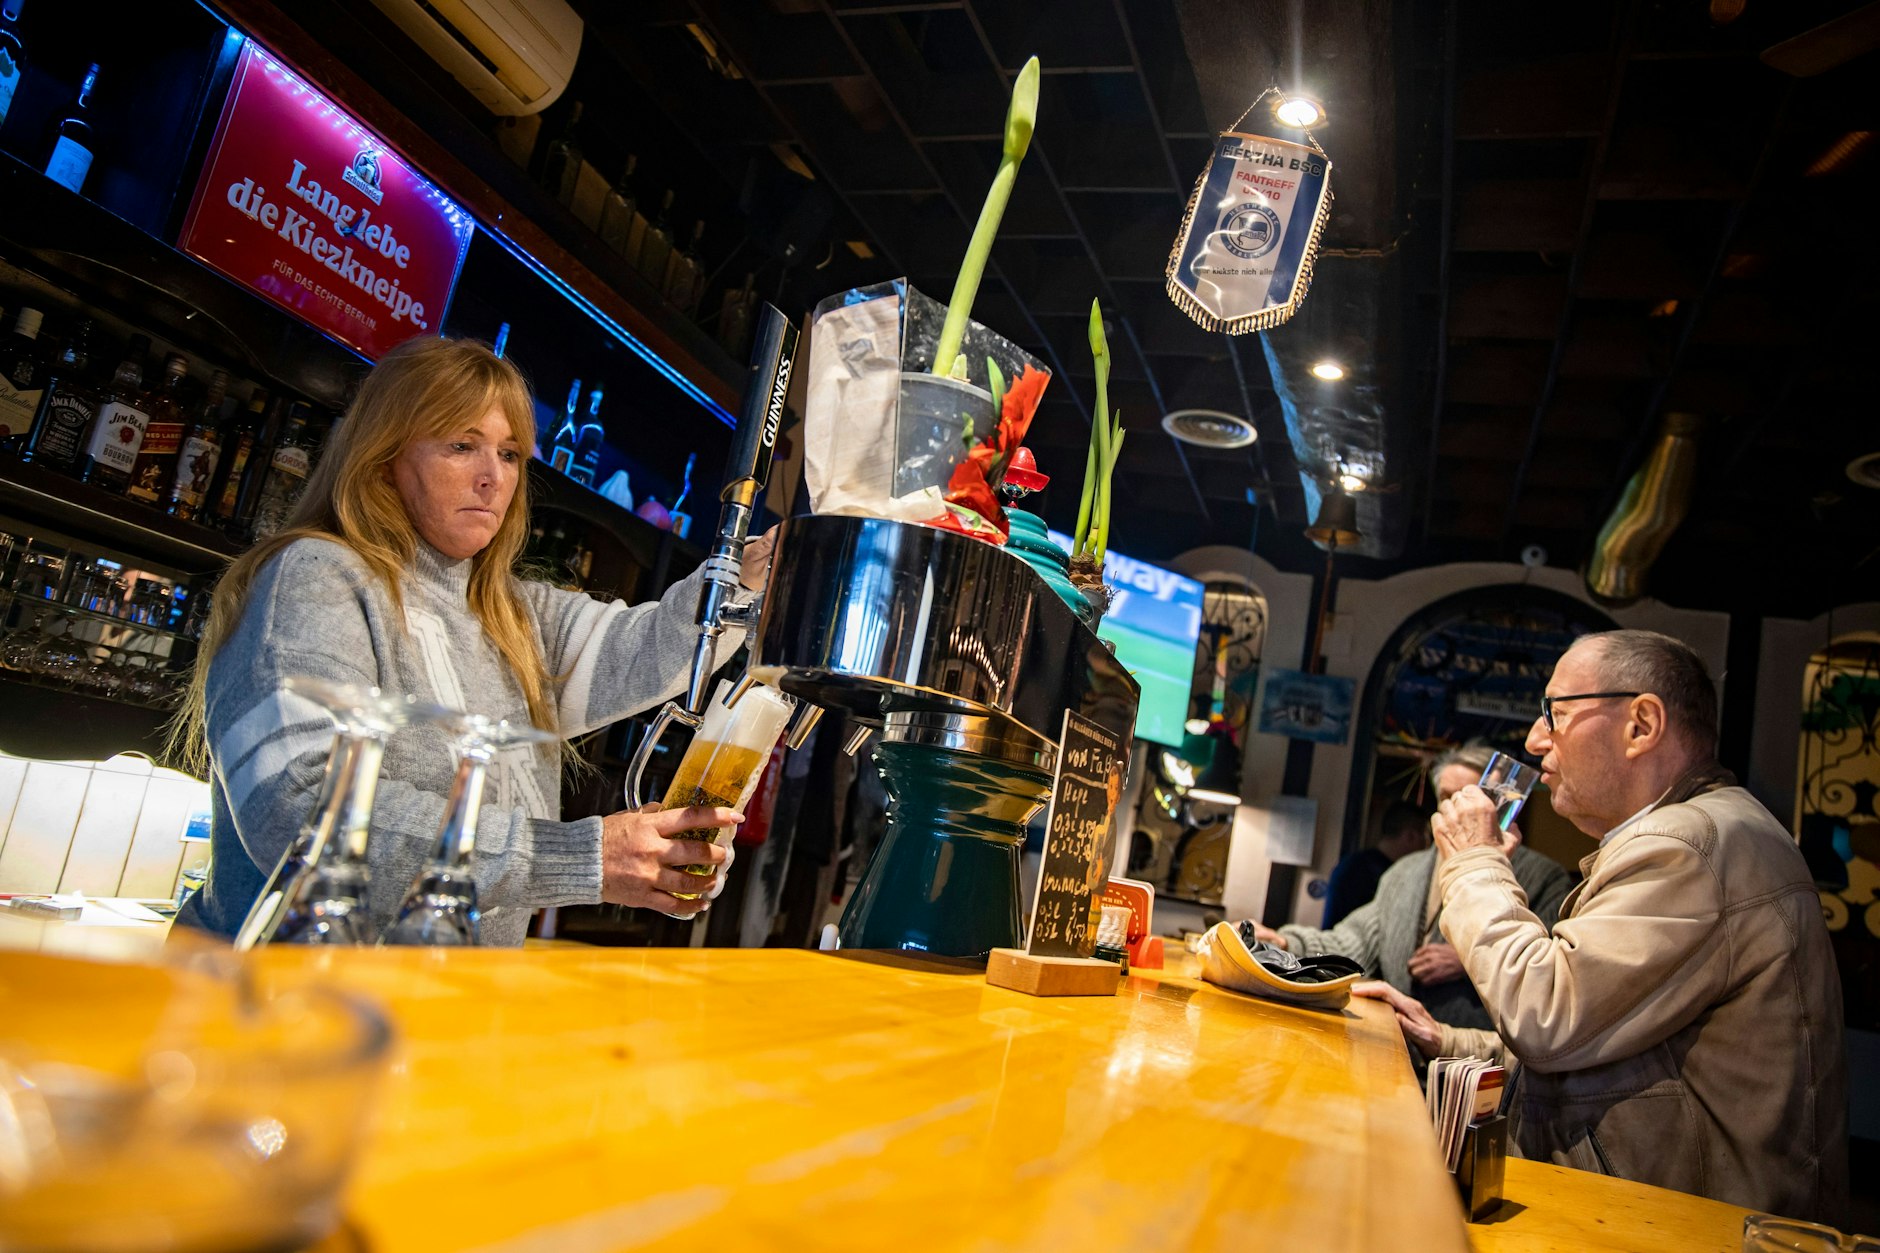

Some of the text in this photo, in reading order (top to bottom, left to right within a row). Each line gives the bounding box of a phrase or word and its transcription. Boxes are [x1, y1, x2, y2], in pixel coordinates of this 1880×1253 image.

[1221, 145, 1323, 177] HERTHA BSC
[1236, 170, 1296, 190] FANTREFF
[285, 158, 411, 269] Lang lebe
[227, 176, 428, 330] die Kiezkneipe.
[272, 258, 378, 332] FÜR DAS ECHTE BERLIN.
[50, 396, 70, 408] JACK
[108, 412, 127, 426] JIM
[762, 355, 792, 448] GUINNESS
